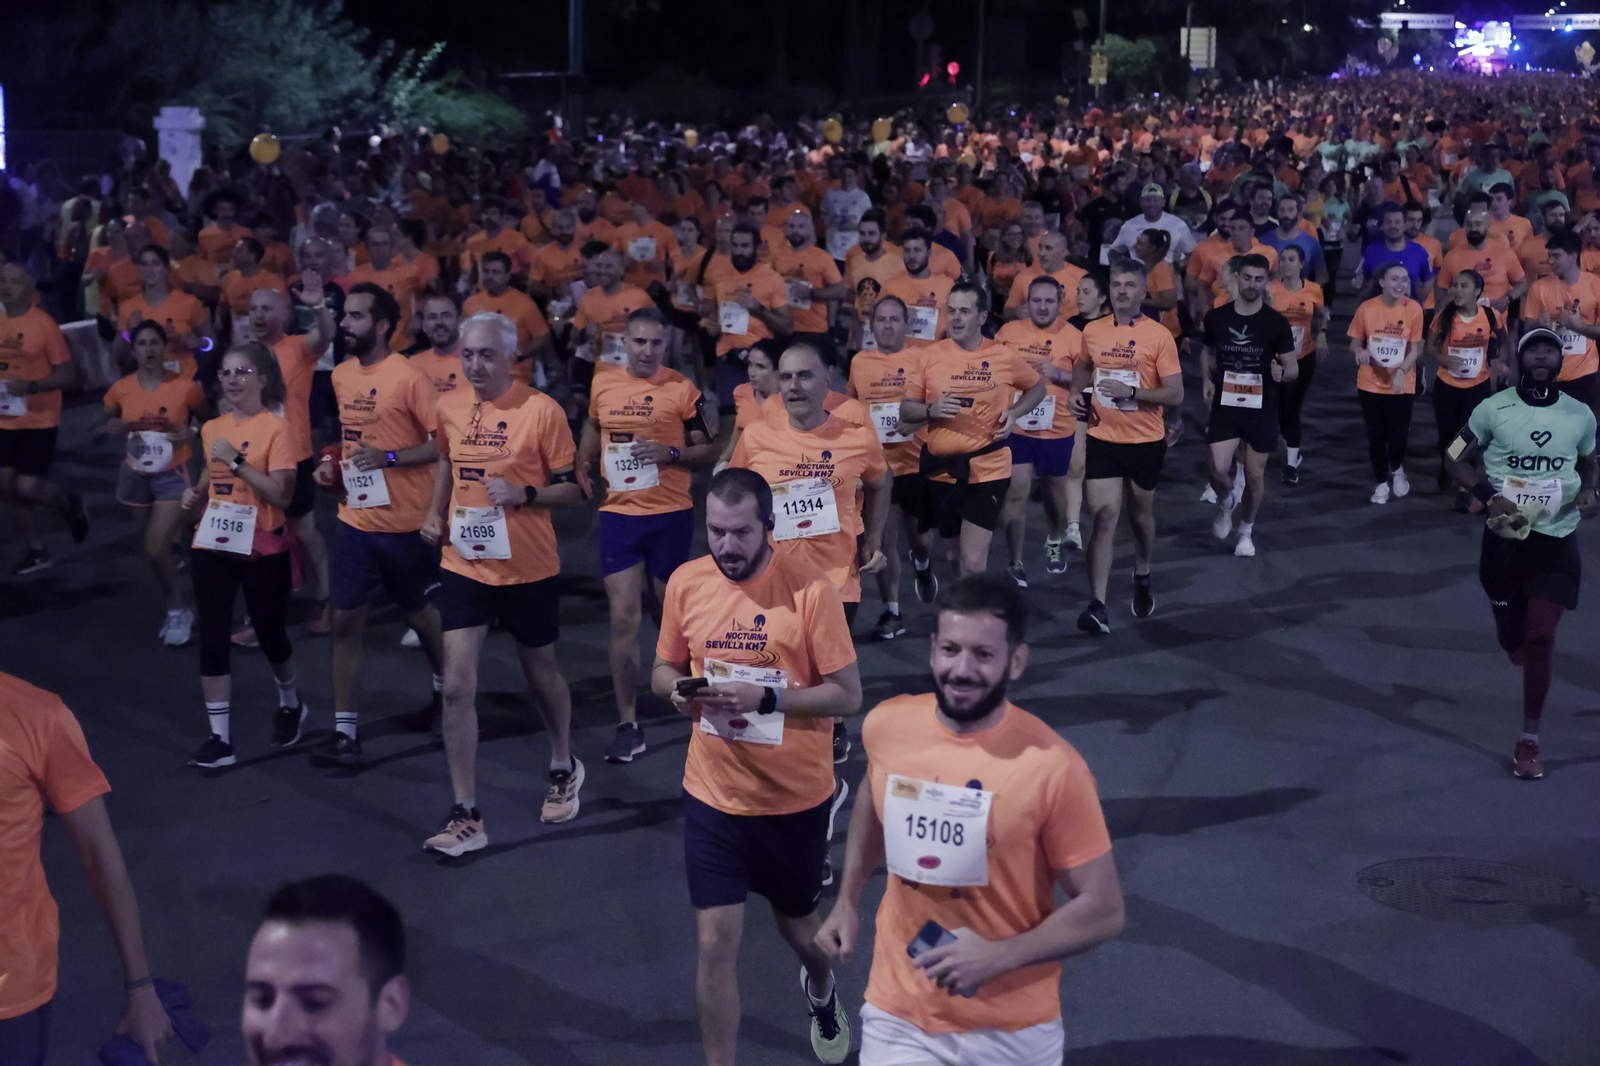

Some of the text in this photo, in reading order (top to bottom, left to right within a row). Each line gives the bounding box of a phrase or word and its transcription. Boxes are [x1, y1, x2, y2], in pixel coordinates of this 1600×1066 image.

[1376, 346, 1398, 355] 16379
[1234, 385, 1253, 394] 1354
[1507, 455, 1565, 471] sano
[779, 469, 834, 478] SEVILLA KH7
[348, 475, 374, 488] 11521
[783, 497, 824, 515] 11314
[210, 516, 243, 533] 11518
[460, 525, 496, 538] 21698
[725, 632, 768, 641] NOCTURNA
[705, 640, 767, 652] SEVILLA KH7
[905, 813, 964, 846] 15108
